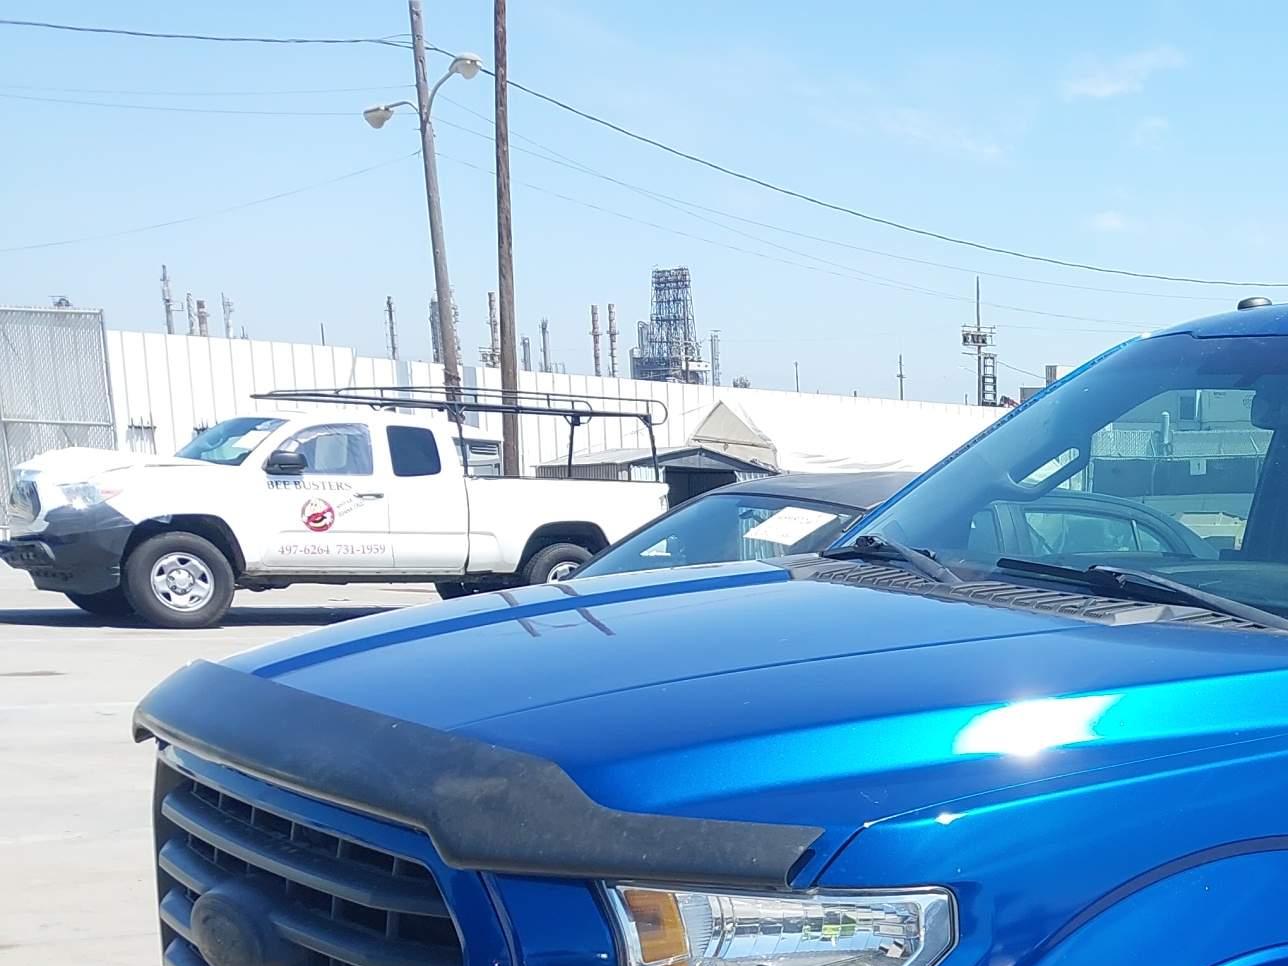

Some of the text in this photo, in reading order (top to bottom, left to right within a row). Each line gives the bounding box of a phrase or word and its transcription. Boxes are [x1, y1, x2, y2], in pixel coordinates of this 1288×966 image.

[267, 480, 353, 491] BEE BUSTERS
[278, 544, 386, 555] 497-6264 731-1959
